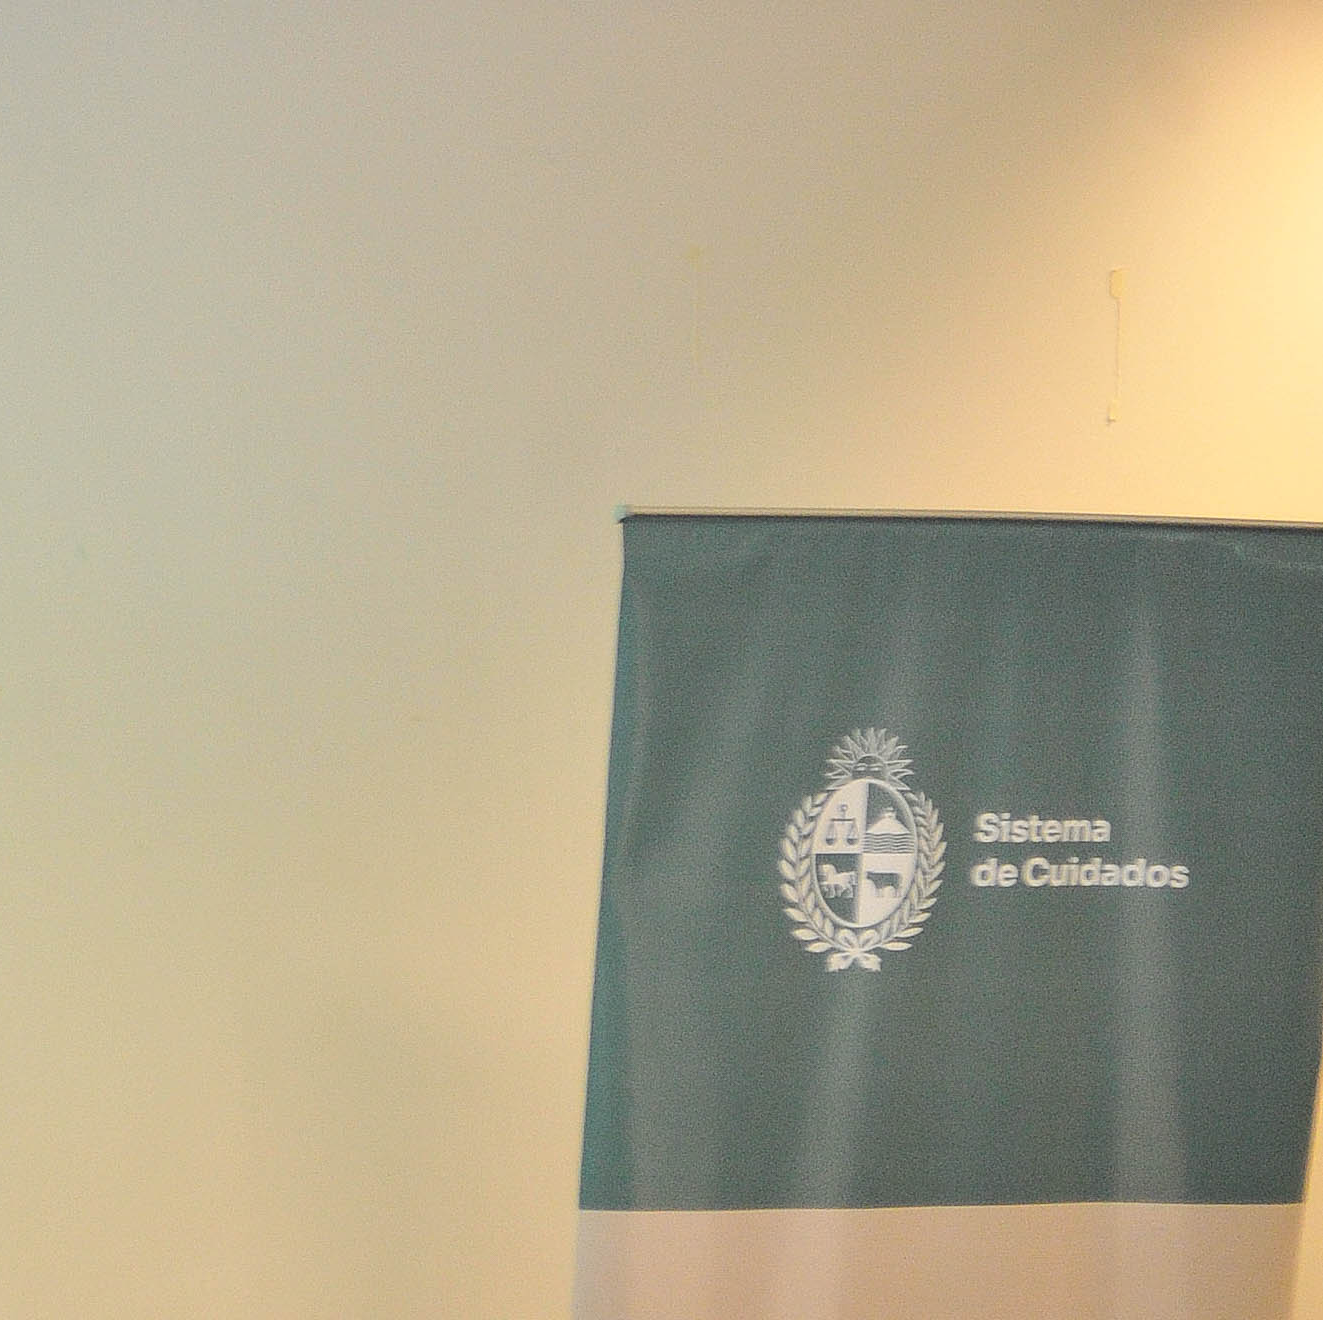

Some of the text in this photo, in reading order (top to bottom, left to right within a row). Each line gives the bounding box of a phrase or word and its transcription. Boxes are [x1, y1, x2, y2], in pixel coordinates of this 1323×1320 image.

[974, 811, 1111, 843] Sistema
[970, 857, 1190, 889] de Cuidados
